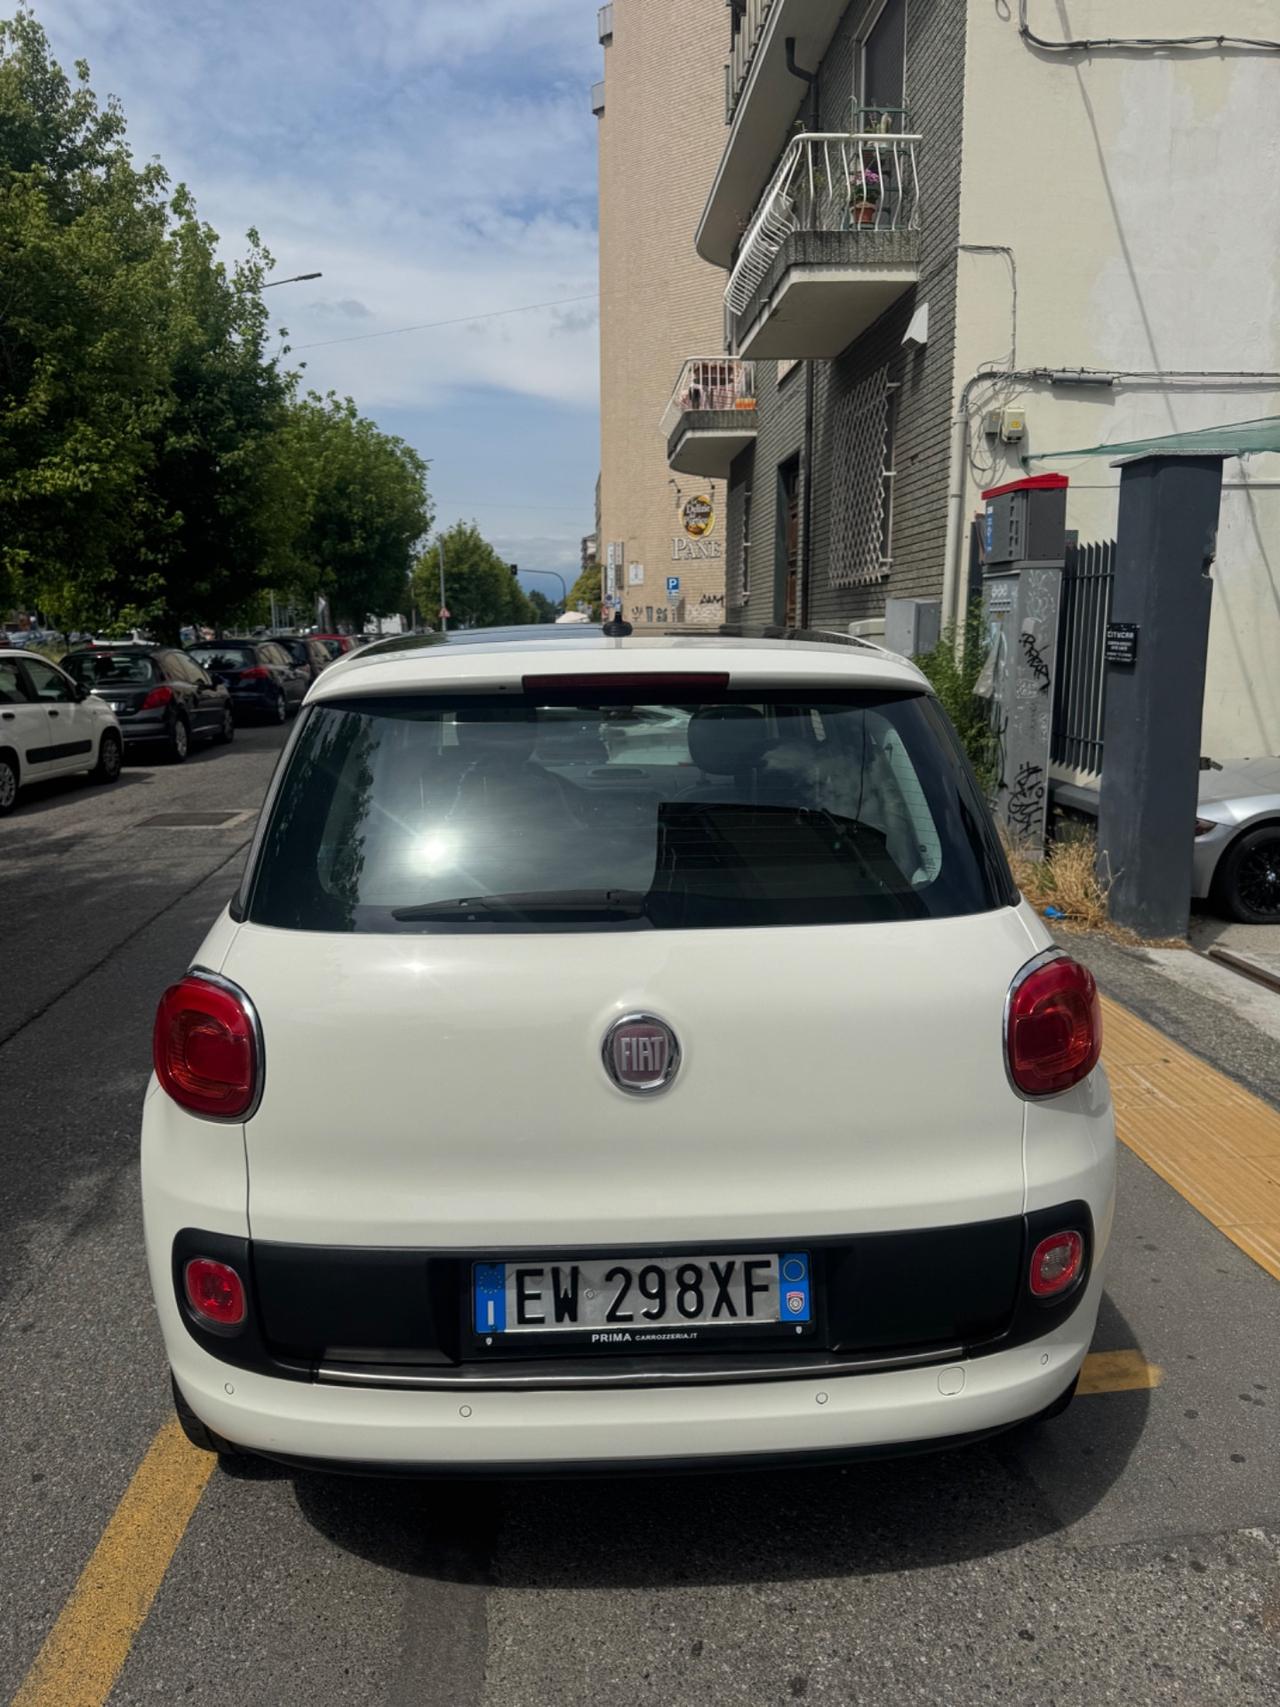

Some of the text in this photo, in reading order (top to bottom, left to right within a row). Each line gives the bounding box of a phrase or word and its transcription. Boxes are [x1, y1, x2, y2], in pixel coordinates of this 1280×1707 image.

[672, 538, 721, 560] PANE
[669, 578, 677, 589] P
[620, 1036, 664, 1072] FIAT
[515, 1260, 771, 1325] EW 298XF
[487, 1300, 495, 1326] I
[591, 1333, 697, 1343] PRIMA CARROZZERIA.IT
